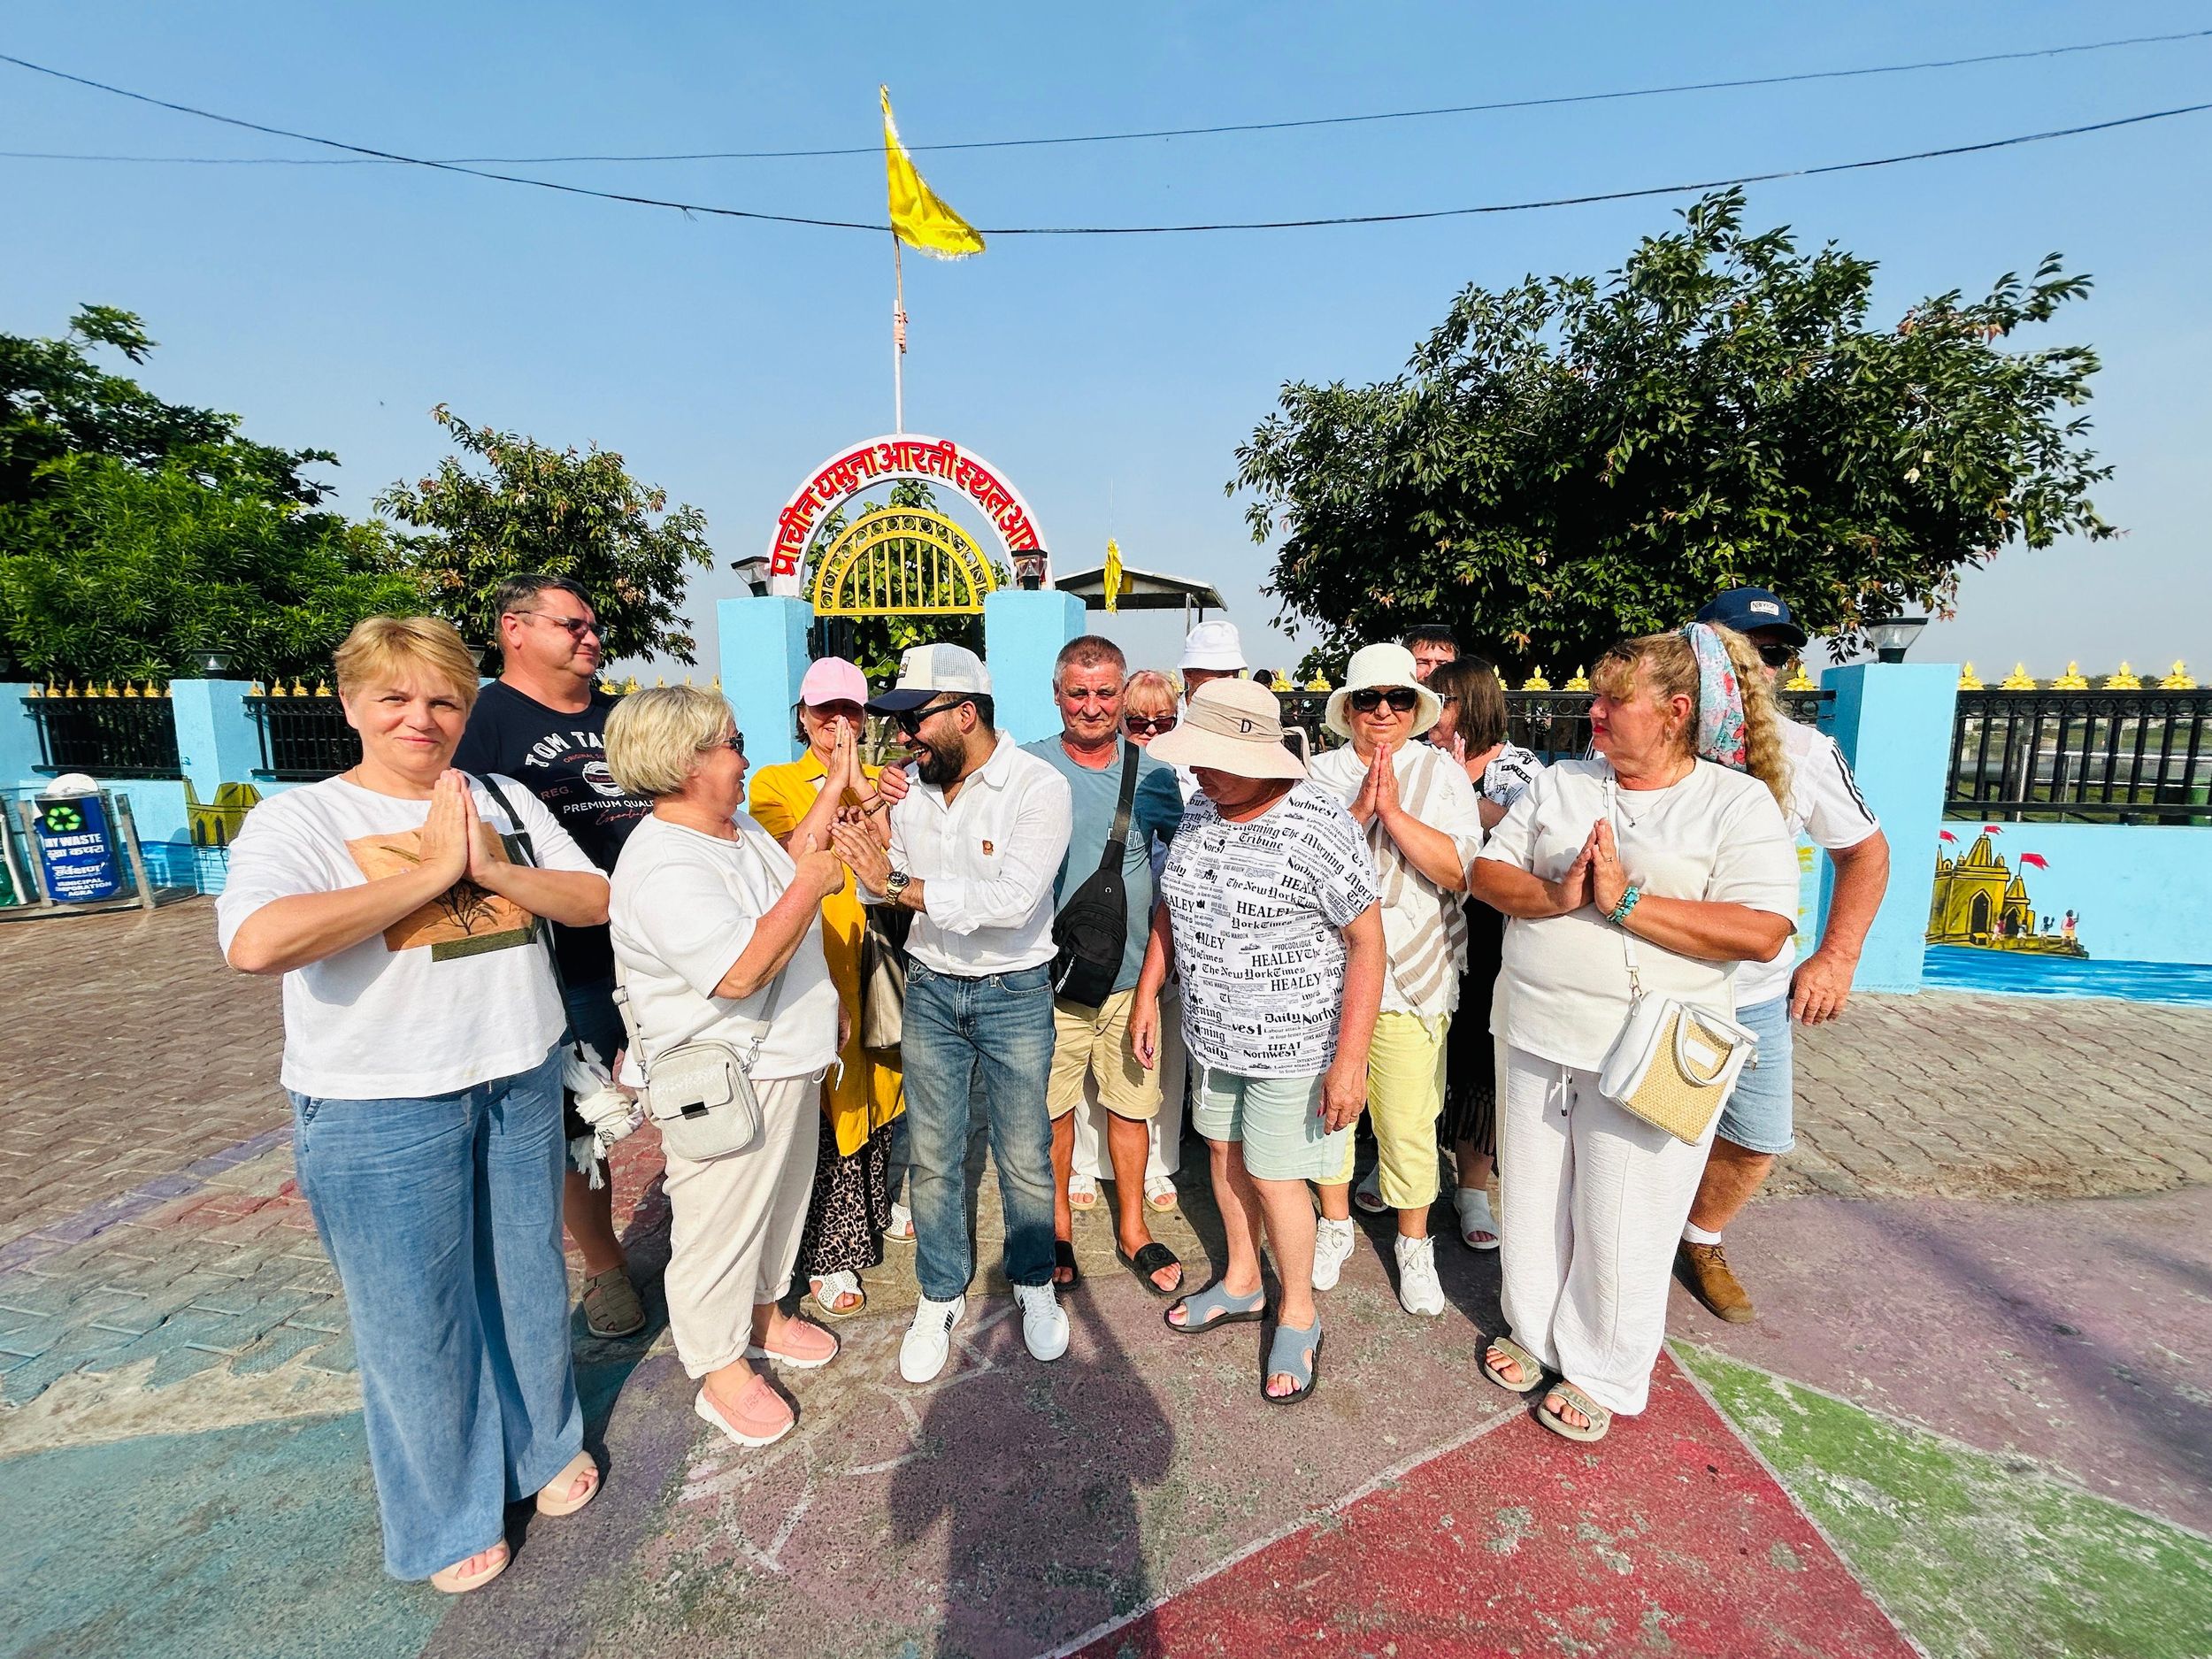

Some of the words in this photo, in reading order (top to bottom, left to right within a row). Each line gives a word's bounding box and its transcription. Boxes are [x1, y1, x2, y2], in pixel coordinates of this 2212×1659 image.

[811, 447, 880, 495] यमुना
[877, 440, 958, 480] आरती
[955, 457, 1016, 522] स्थल
[1240, 718, 1252, 733] D
[525, 733, 572, 768] TOM
[570, 731, 605, 749] TA
[541, 786, 572, 800] REG.
[563, 800, 621, 814] PREMIUM
[59, 833, 103, 846] WASTE
[1239, 833, 1284, 849] Tribune
[1251, 949, 1304, 967] HEALEY
[1271, 972, 1322, 992] HEALEY
[1264, 1012, 1302, 1024] Daily
